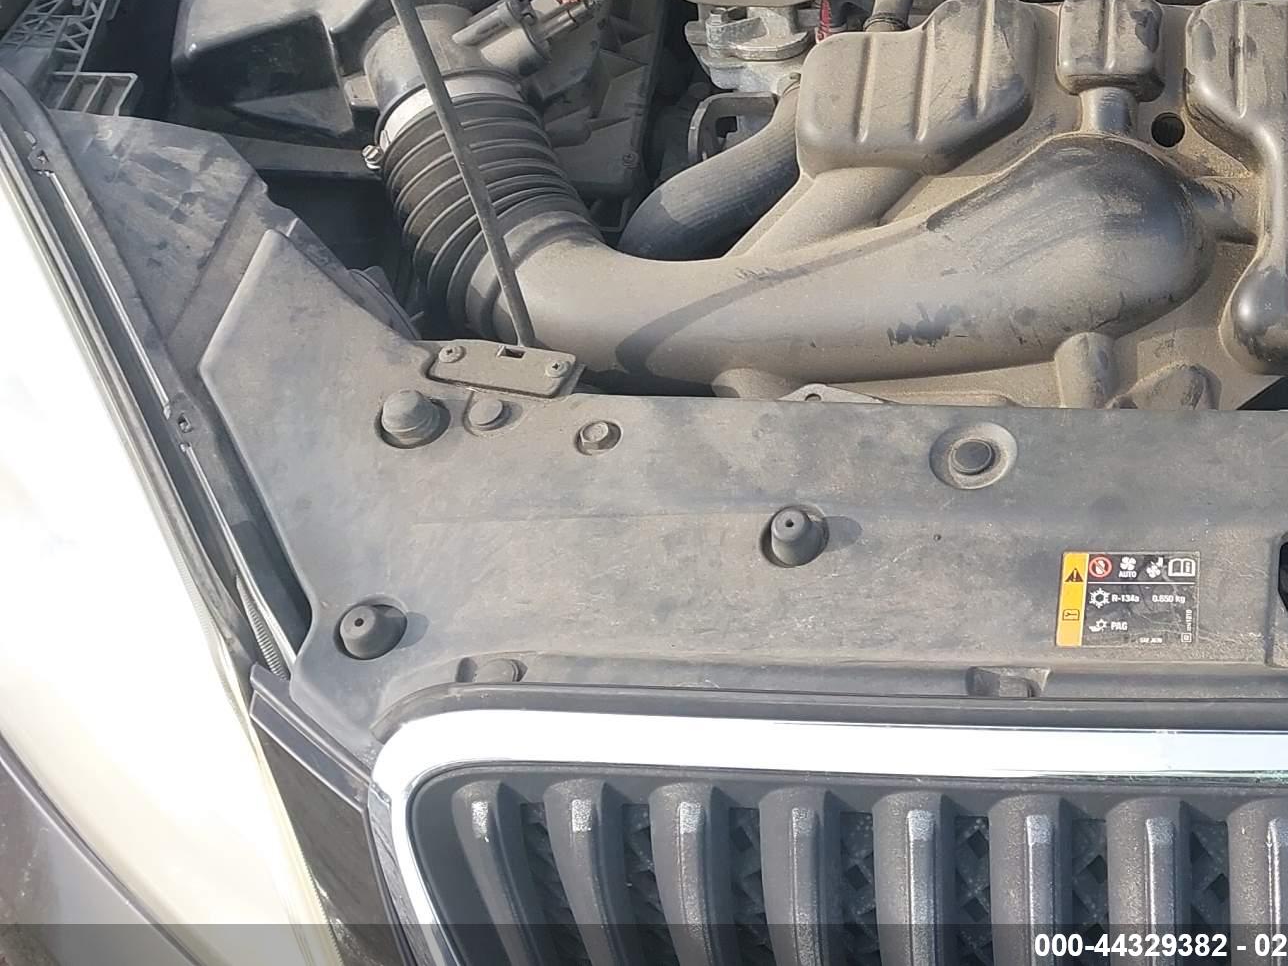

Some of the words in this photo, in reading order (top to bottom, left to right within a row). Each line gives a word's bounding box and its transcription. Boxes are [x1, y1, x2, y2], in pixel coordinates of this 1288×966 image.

[1118, 570, 1137, 578] AUTO
[1111, 594, 1140, 603] R-134a
[1175, 594, 1186, 604] kg
[1110, 621, 1128, 631] PAG
